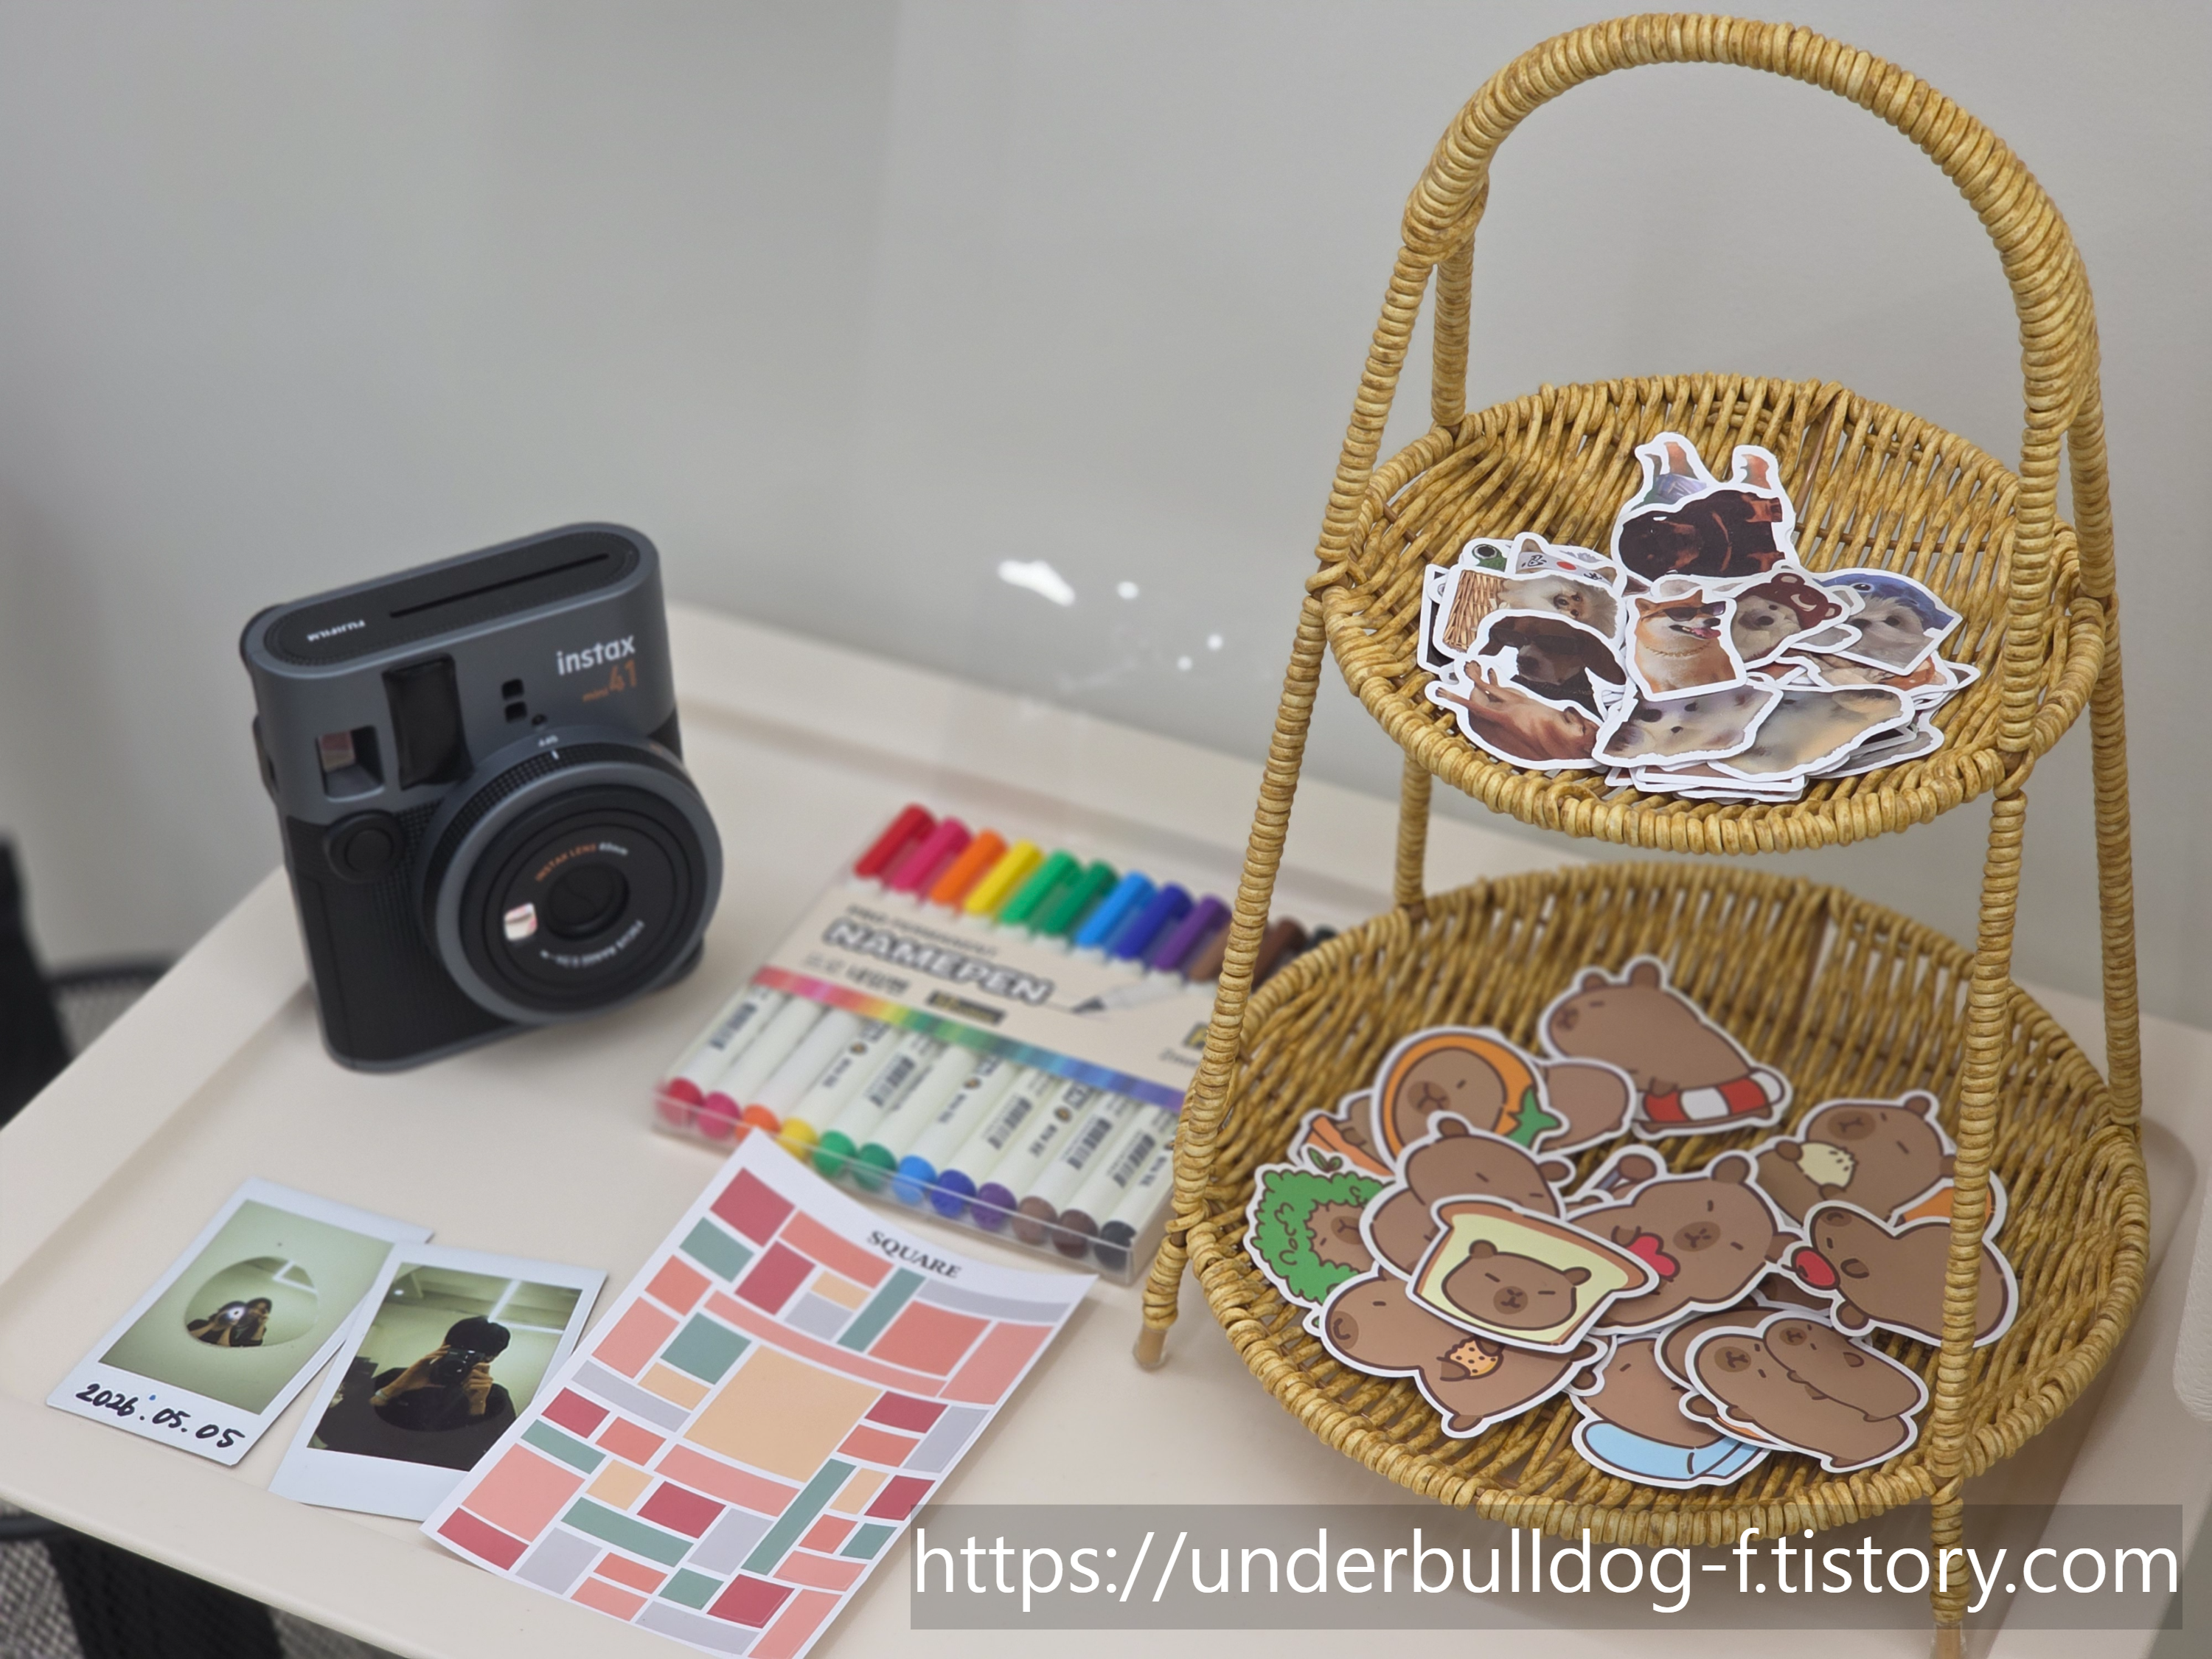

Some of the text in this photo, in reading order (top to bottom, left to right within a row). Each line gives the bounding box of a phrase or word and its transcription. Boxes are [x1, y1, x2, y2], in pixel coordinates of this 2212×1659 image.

[556, 634, 636, 675] instax
[608, 659, 638, 692] 41
[822, 918, 1056, 1005] NAMEPEN
[867, 1230, 962, 1279] SQUARE
